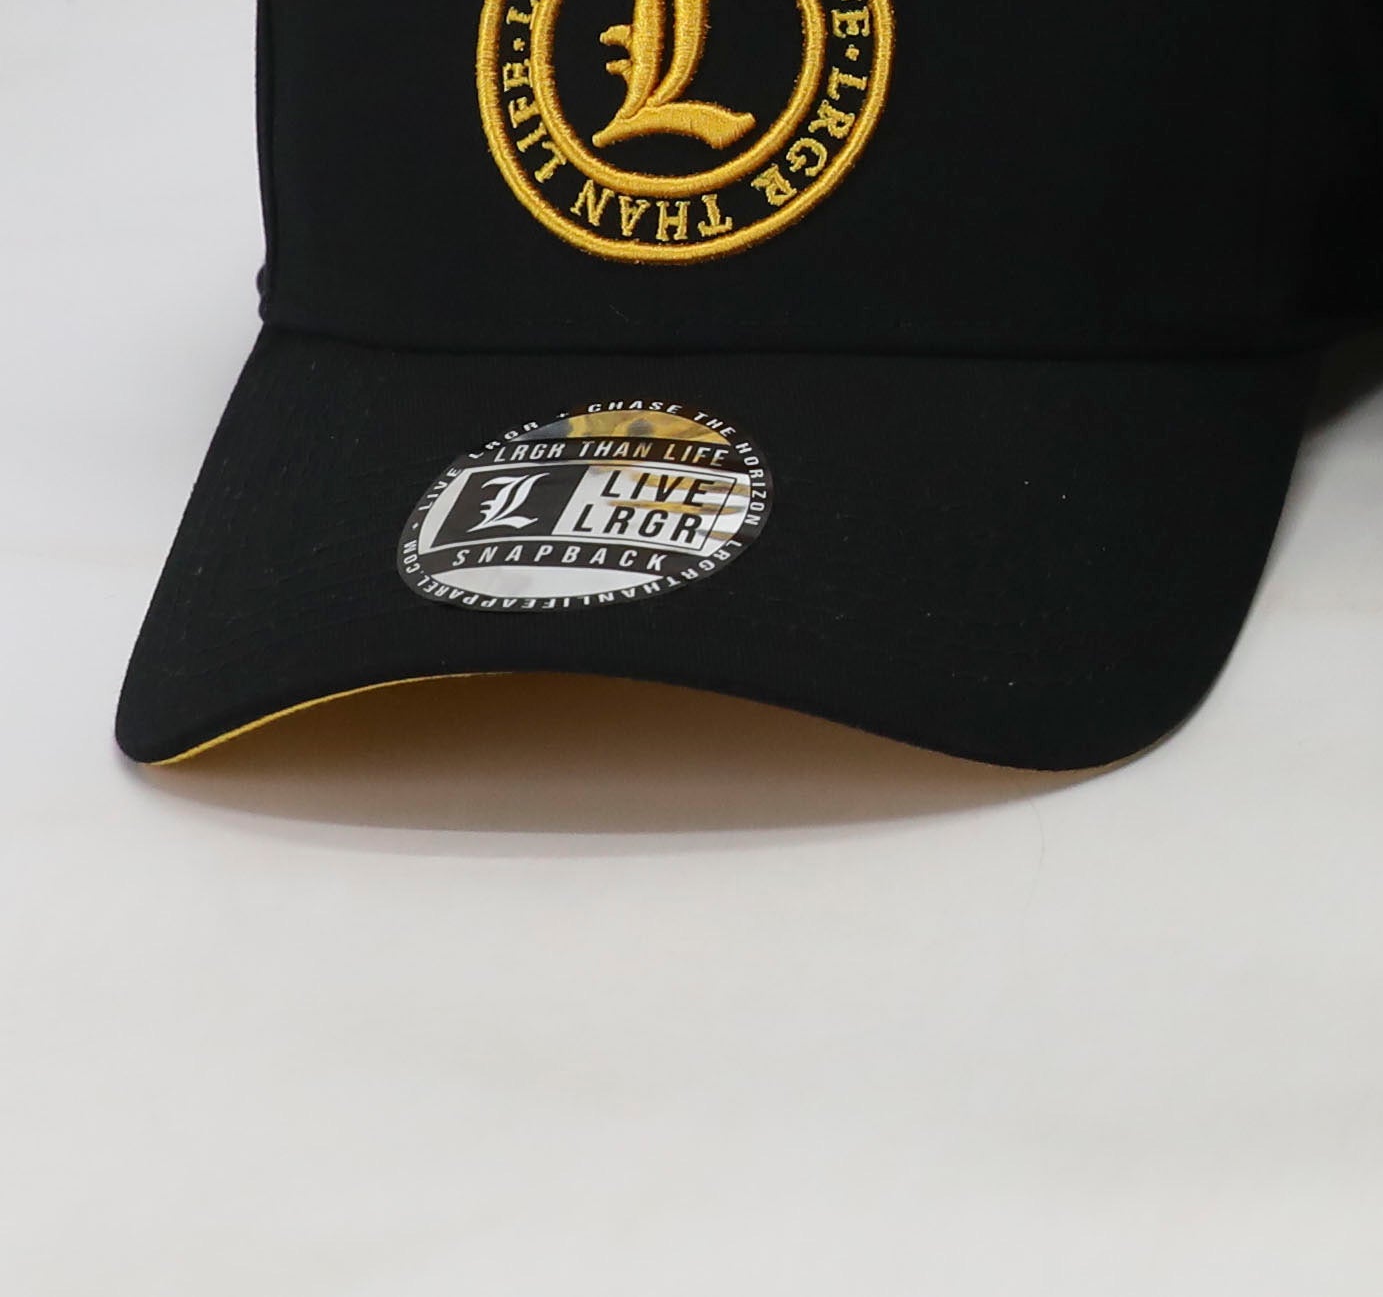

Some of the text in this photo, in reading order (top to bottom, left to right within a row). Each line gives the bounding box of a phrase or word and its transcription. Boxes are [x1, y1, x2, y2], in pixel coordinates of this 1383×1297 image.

[503, 57, 868, 242] LRGR THAN LIFE
[418, 400, 767, 526] LIVE LRGR CHASE THE HORIZON
[493, 440, 729, 467] LRGR THAN LIFE
[466, 472, 551, 533] L
[600, 470, 715, 507] LIVE
[572, 504, 703, 544] LRGR
[452, 544, 667, 571] SNAPBACK
